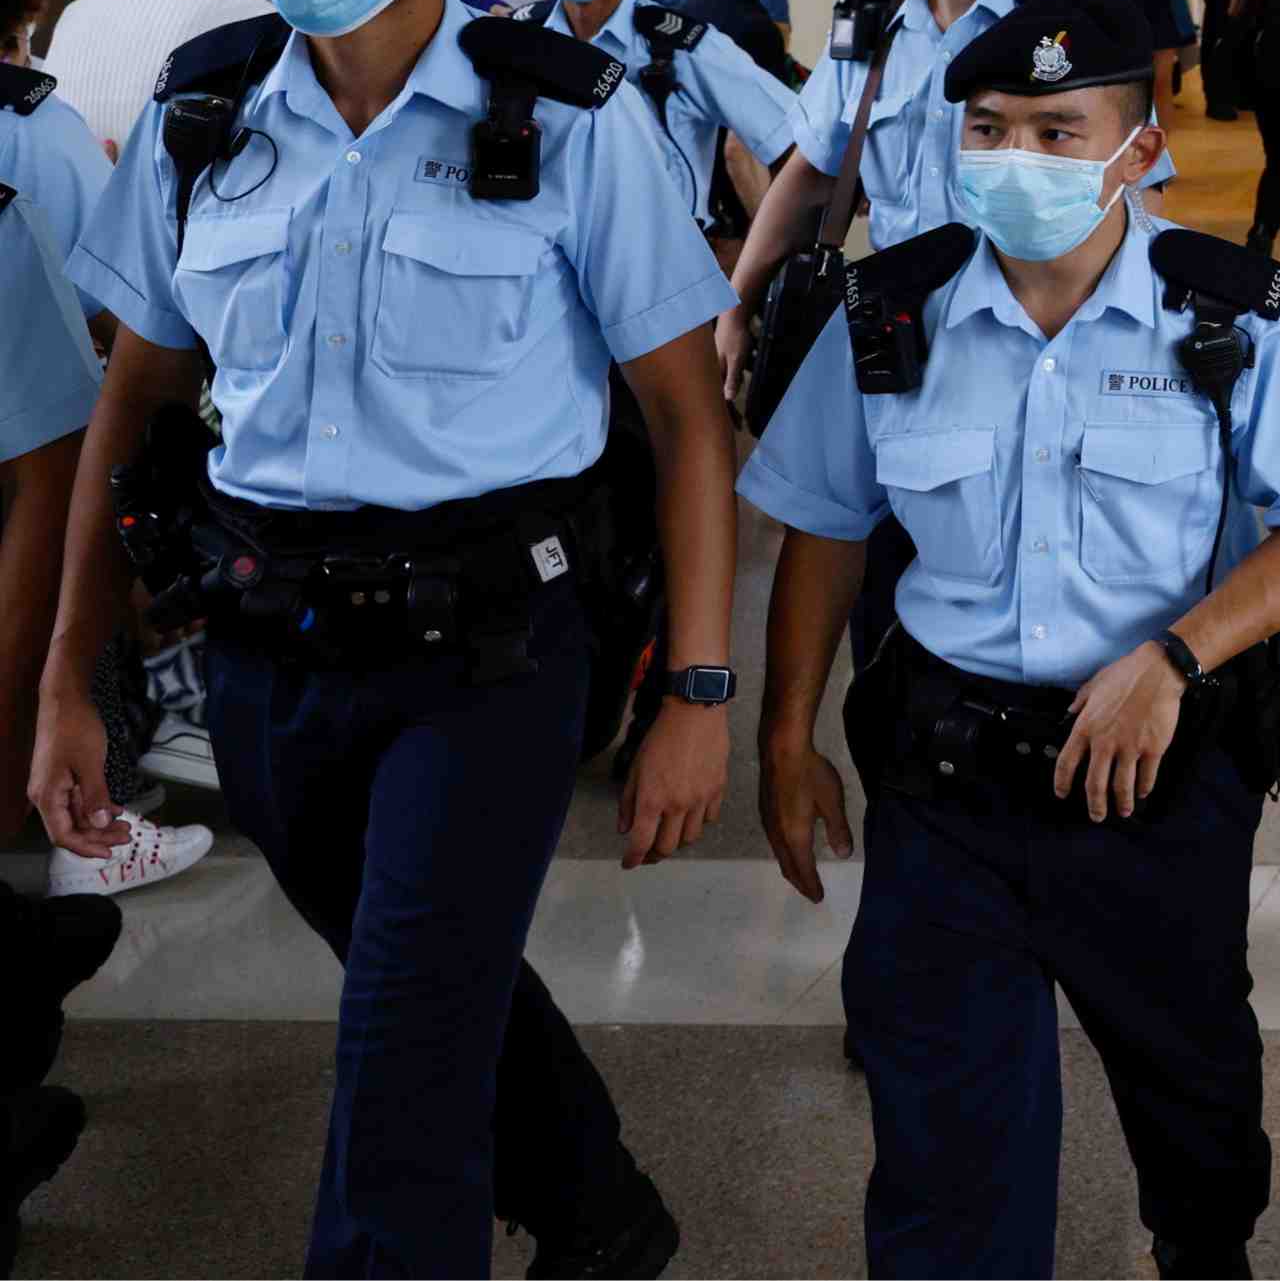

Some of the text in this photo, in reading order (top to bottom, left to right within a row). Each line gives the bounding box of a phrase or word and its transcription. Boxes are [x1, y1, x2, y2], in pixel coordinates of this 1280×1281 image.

[592, 61, 624, 99] 26420
[423, 159, 442, 179] 警
[845, 267, 860, 312] 24651
[1107, 373, 1189, 394] 警 POLICE
[545, 546, 564, 569] JFT
